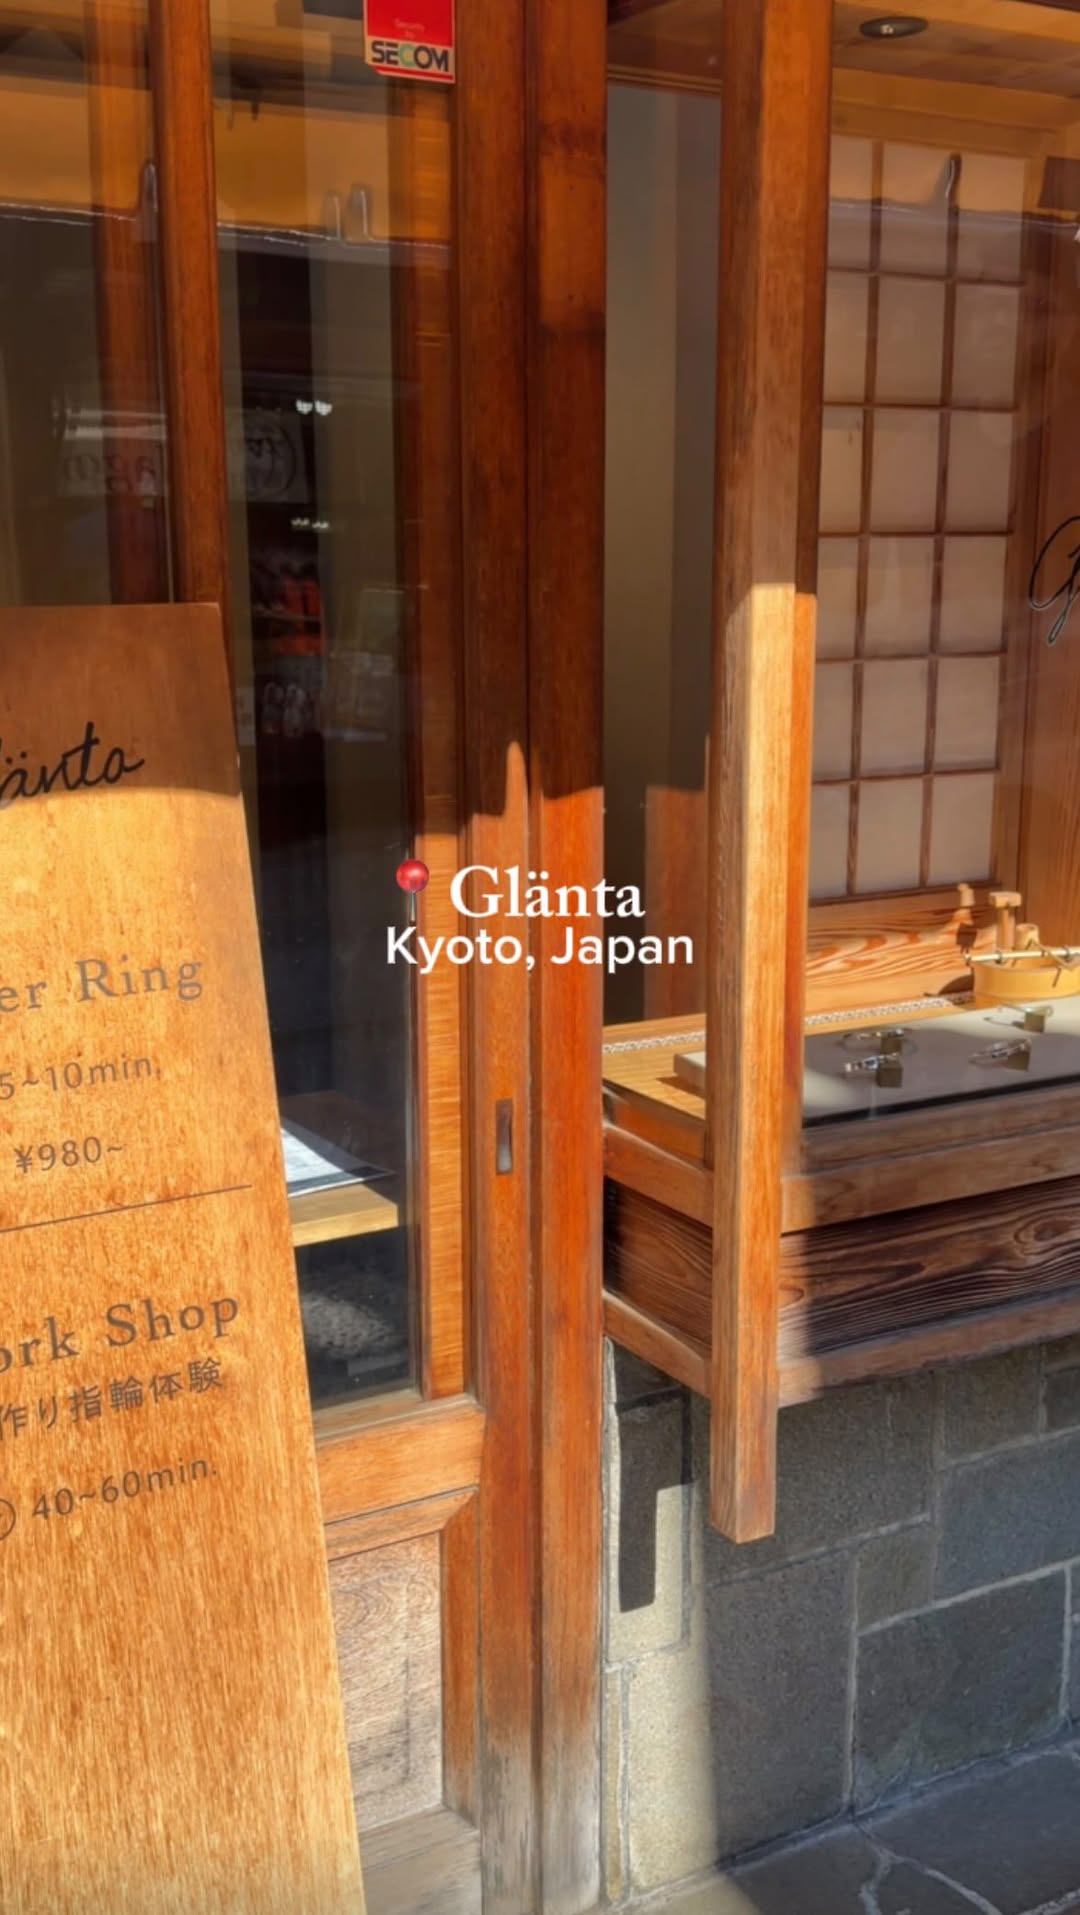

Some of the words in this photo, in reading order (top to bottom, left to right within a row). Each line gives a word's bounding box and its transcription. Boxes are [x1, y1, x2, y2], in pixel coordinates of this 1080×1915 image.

[371, 40, 449, 72] SECOM
[0, 721, 145, 809] änta
[76, 953, 203, 1001] Ring
[105, 1297, 239, 1348] Shop
[0, 1356, 226, 1442] 作り指輪体験
